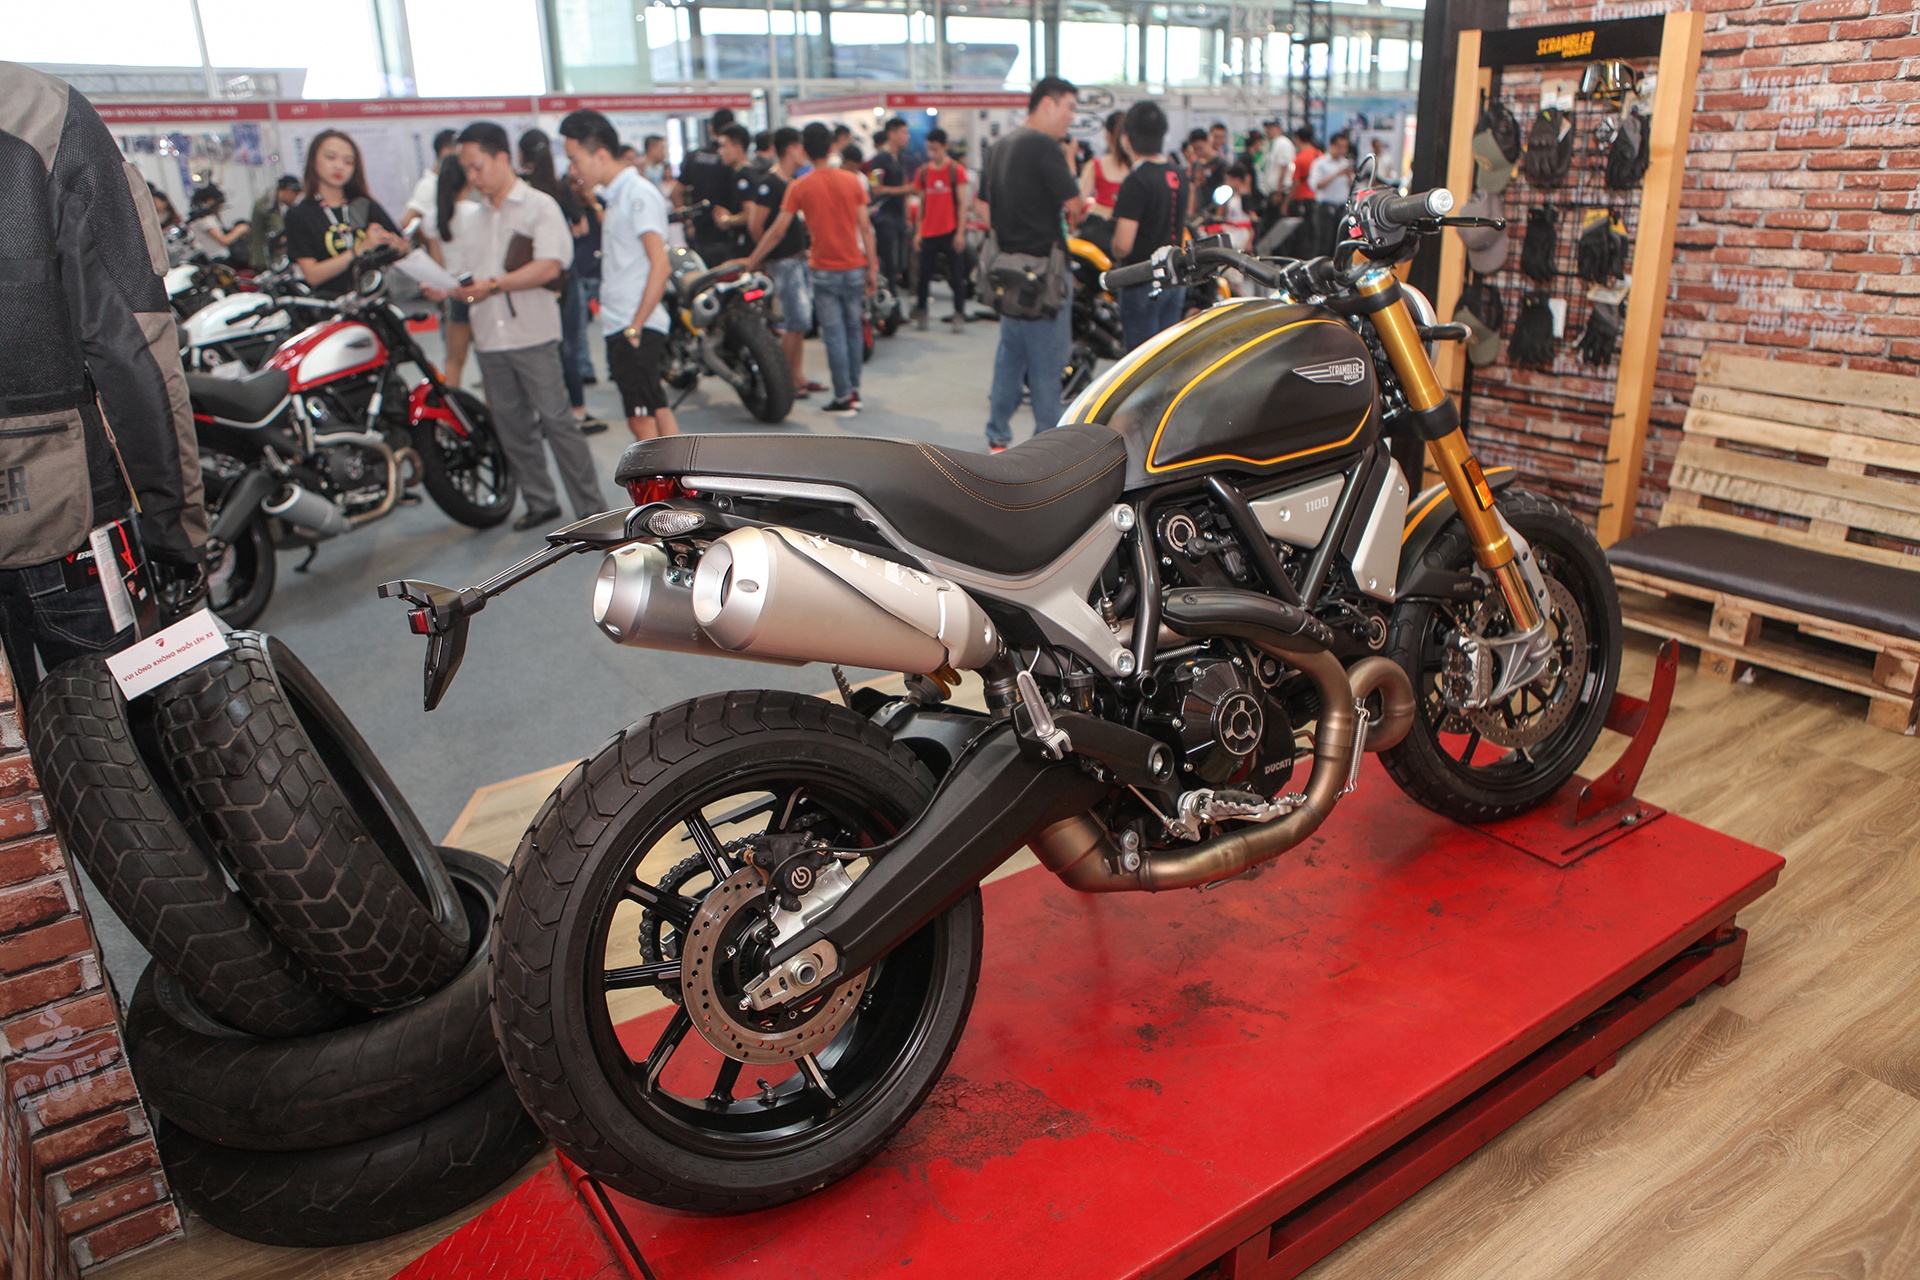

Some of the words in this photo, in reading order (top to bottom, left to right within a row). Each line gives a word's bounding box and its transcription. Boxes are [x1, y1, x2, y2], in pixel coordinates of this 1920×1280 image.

[1536, 30, 1595, 55] SCRAMBLER
[1742, 76, 1792, 97] WAKE
[1794, 74, 1819, 95] UP
[1778, 116, 1816, 138] CUP
[1818, 114, 1844, 139] OF
[1847, 112, 1919, 137] COFFEE
[1748, 313, 1782, 336] CUP
[1784, 316, 1808, 338] OF
[1328, 363, 1360, 377] SCRAMBLER
[1305, 495, 1329, 512] 1100
[122, 674, 134, 682] VUI
[134, 664, 152, 677] LÒNG
[153, 651, 176, 666] KHÔNG
[194, 636, 205, 645] LÊN
[205, 631, 214, 639] XE
[1264, 758, 1292, 775] DUCATI
[14, 1046, 120, 1112] COFF
